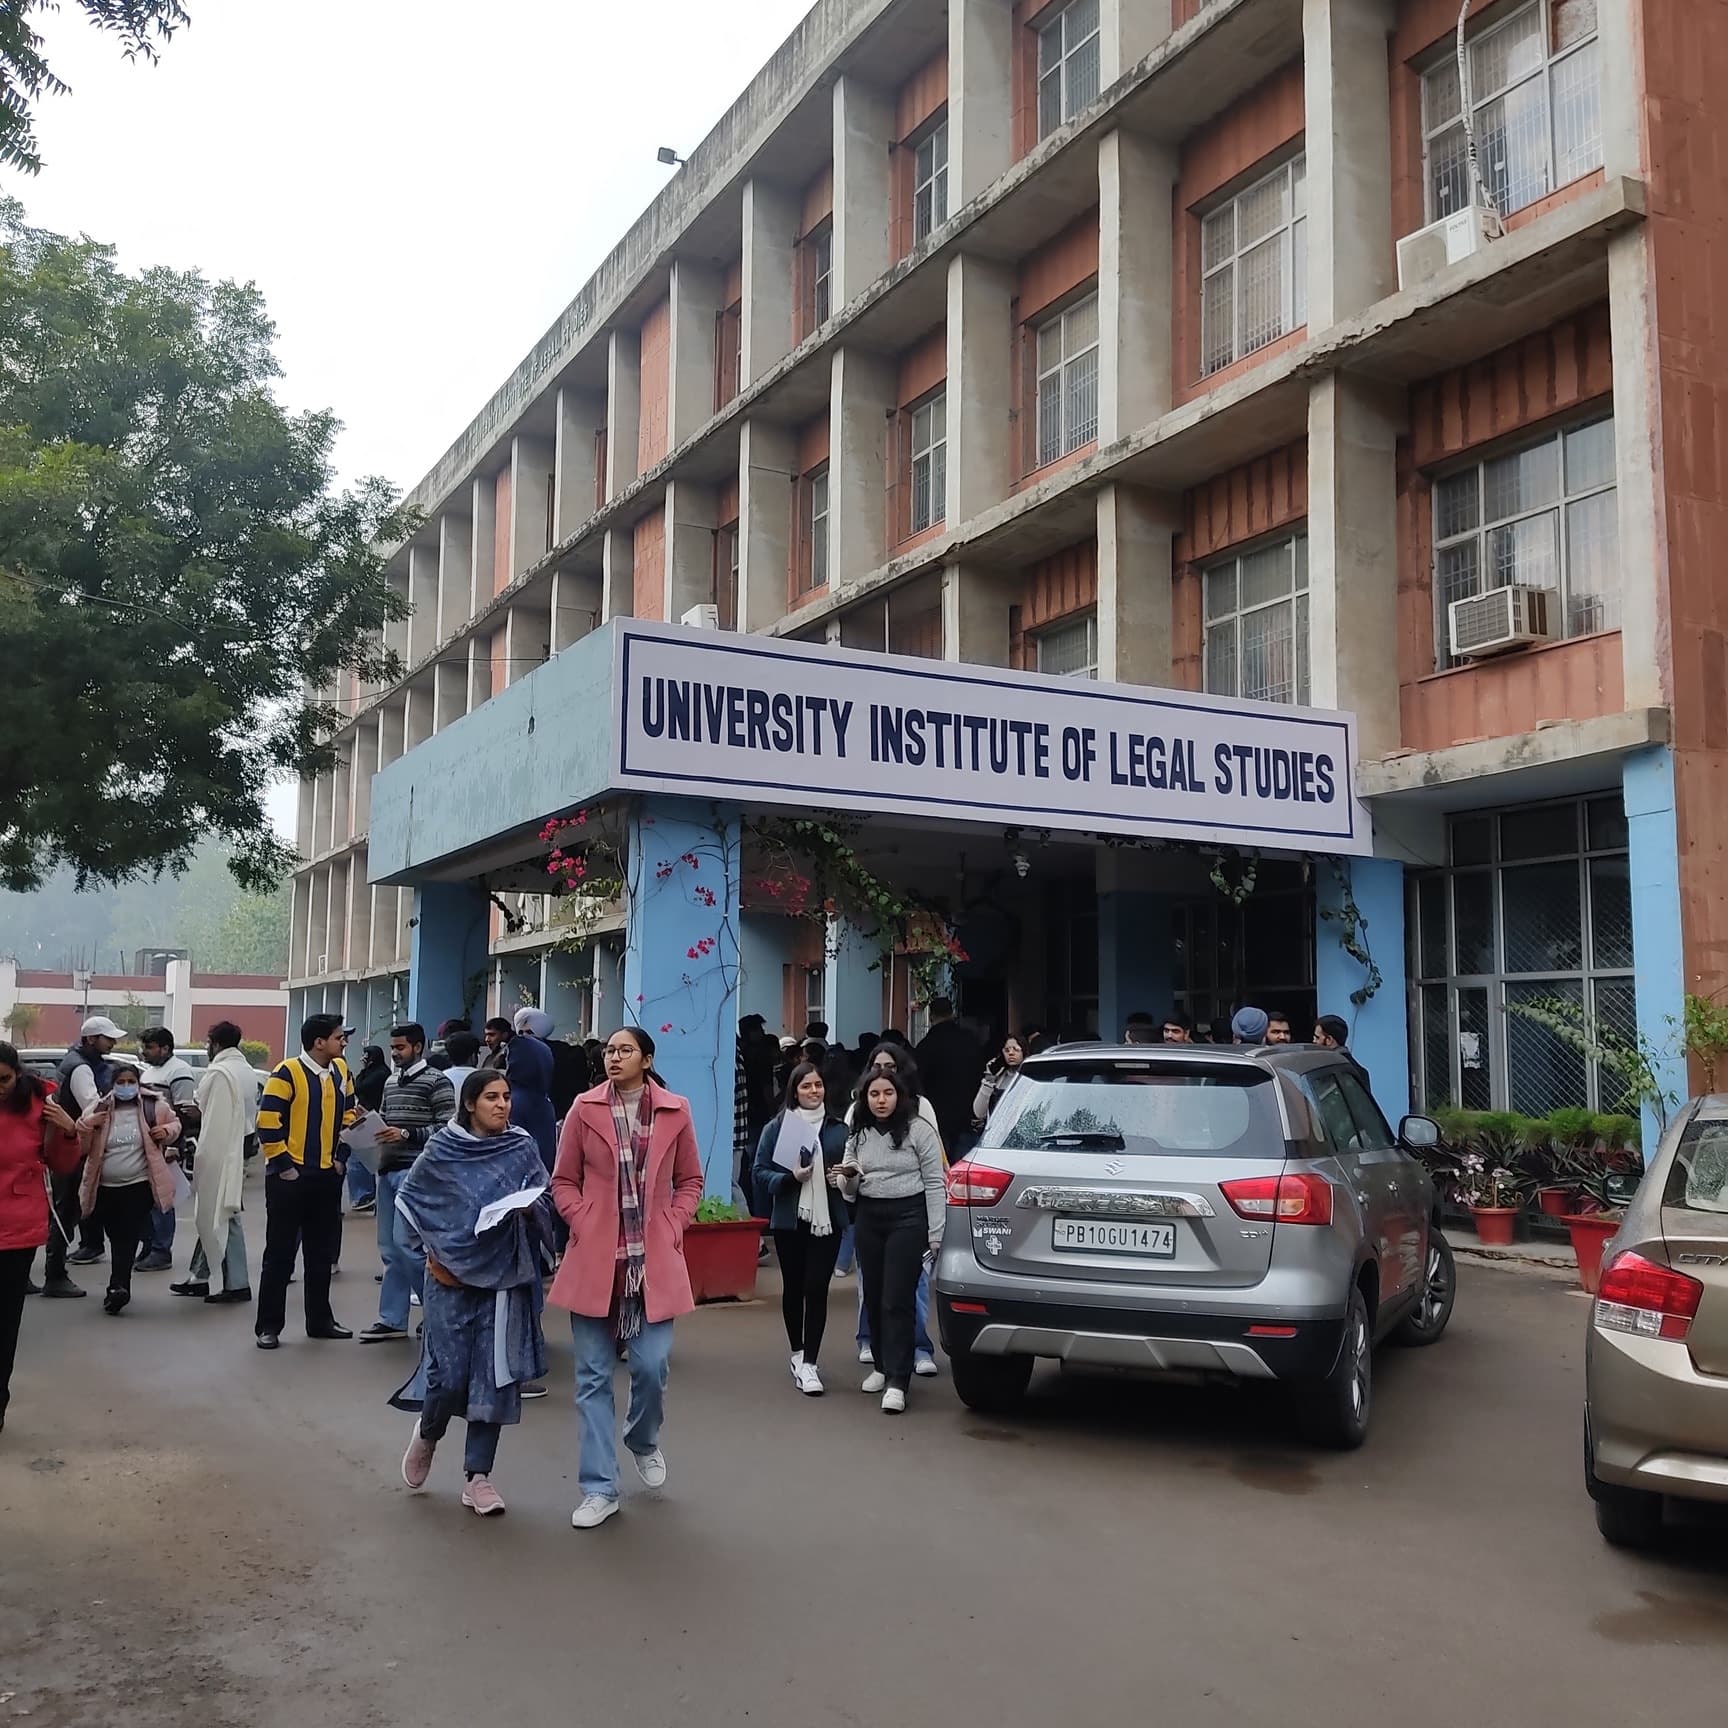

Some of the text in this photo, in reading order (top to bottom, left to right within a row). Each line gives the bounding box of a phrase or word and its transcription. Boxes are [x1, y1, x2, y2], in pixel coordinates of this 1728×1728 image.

[642, 676, 1335, 804] UNIVERSITY INSTITUTE OF LEGAL STUDIES
[983, 1227, 1012, 1236] SWANI
[1066, 1225, 1171, 1249] PB10GU1474
